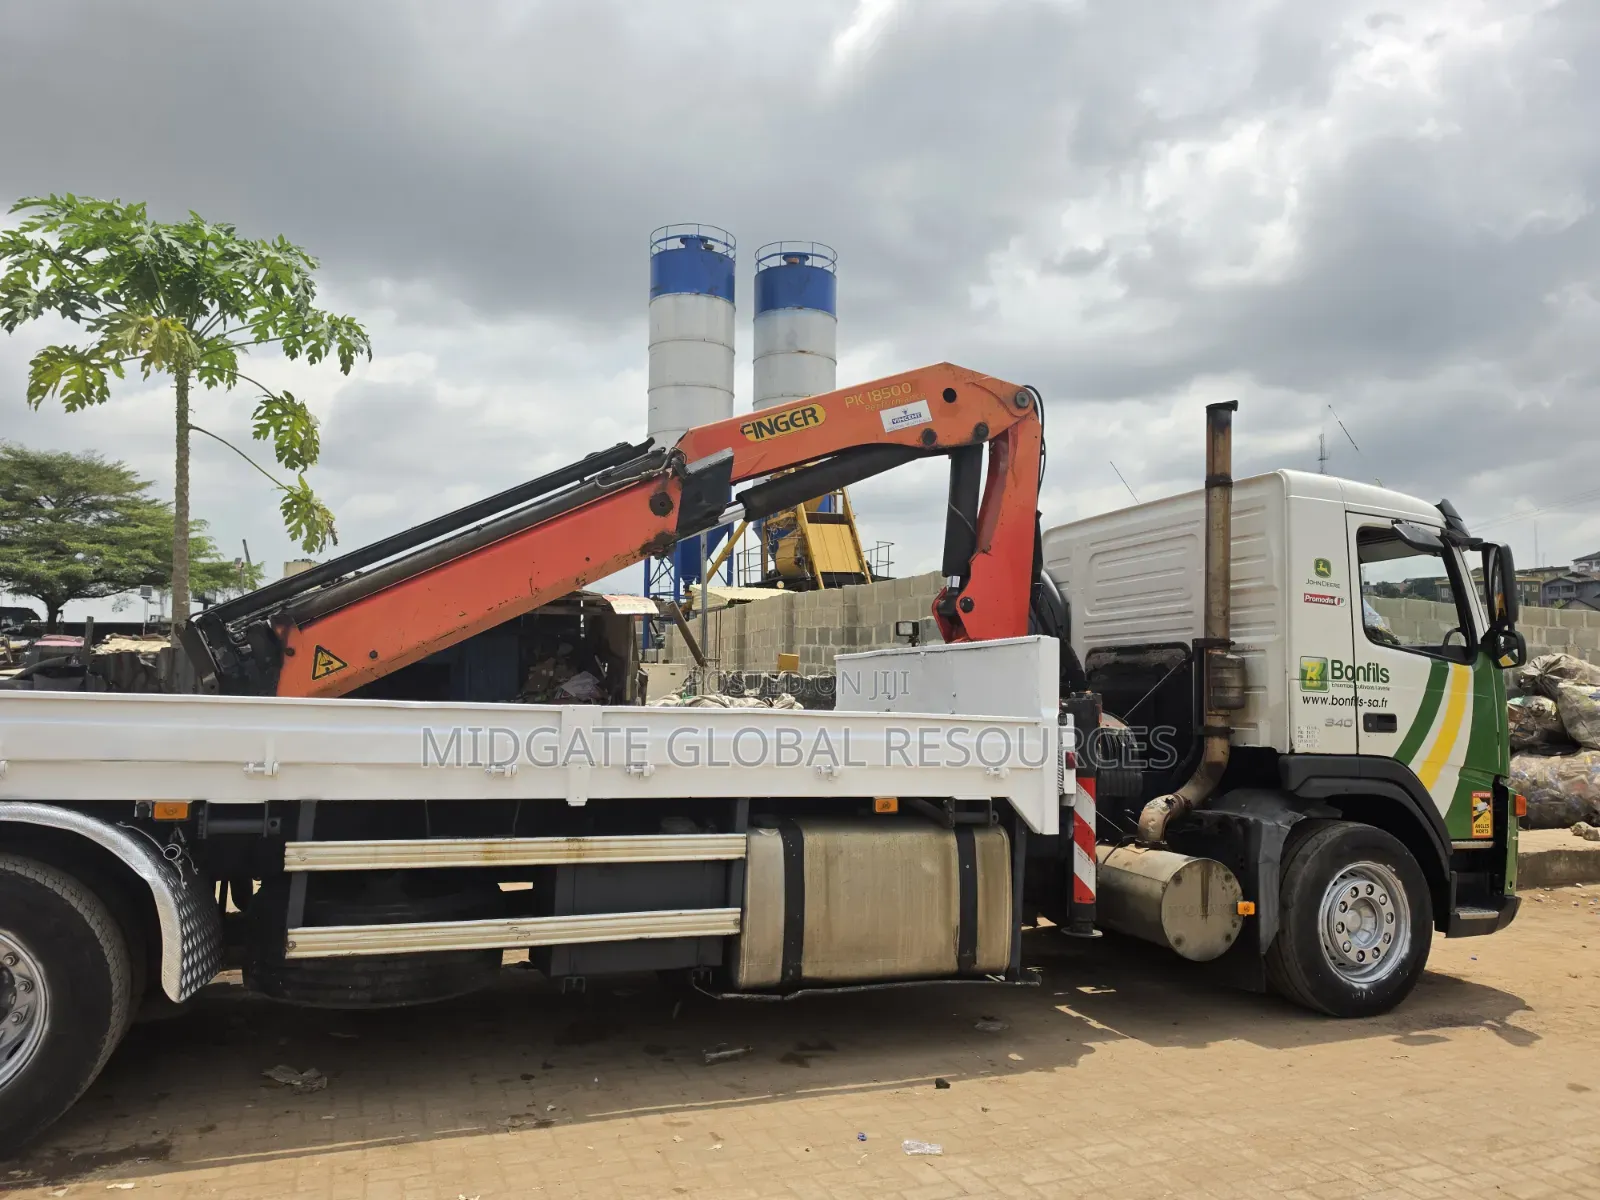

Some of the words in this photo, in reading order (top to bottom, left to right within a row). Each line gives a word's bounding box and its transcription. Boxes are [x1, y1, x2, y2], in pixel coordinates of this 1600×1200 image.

[845, 395, 864, 408] PK
[867, 382, 912, 402] 18500
[740, 407, 819, 439] FINGER
[891, 411, 922, 425] VINCENT
[1305, 578, 1321, 586] JOHN
[1322, 580, 1340, 589] DEERE
[1304, 594, 1334, 604] Promodis
[1331, 659, 1390, 683] Bonfils
[1302, 694, 1388, 708] www.bonfls-sa.fr
[1324, 718, 1353, 728] 340
